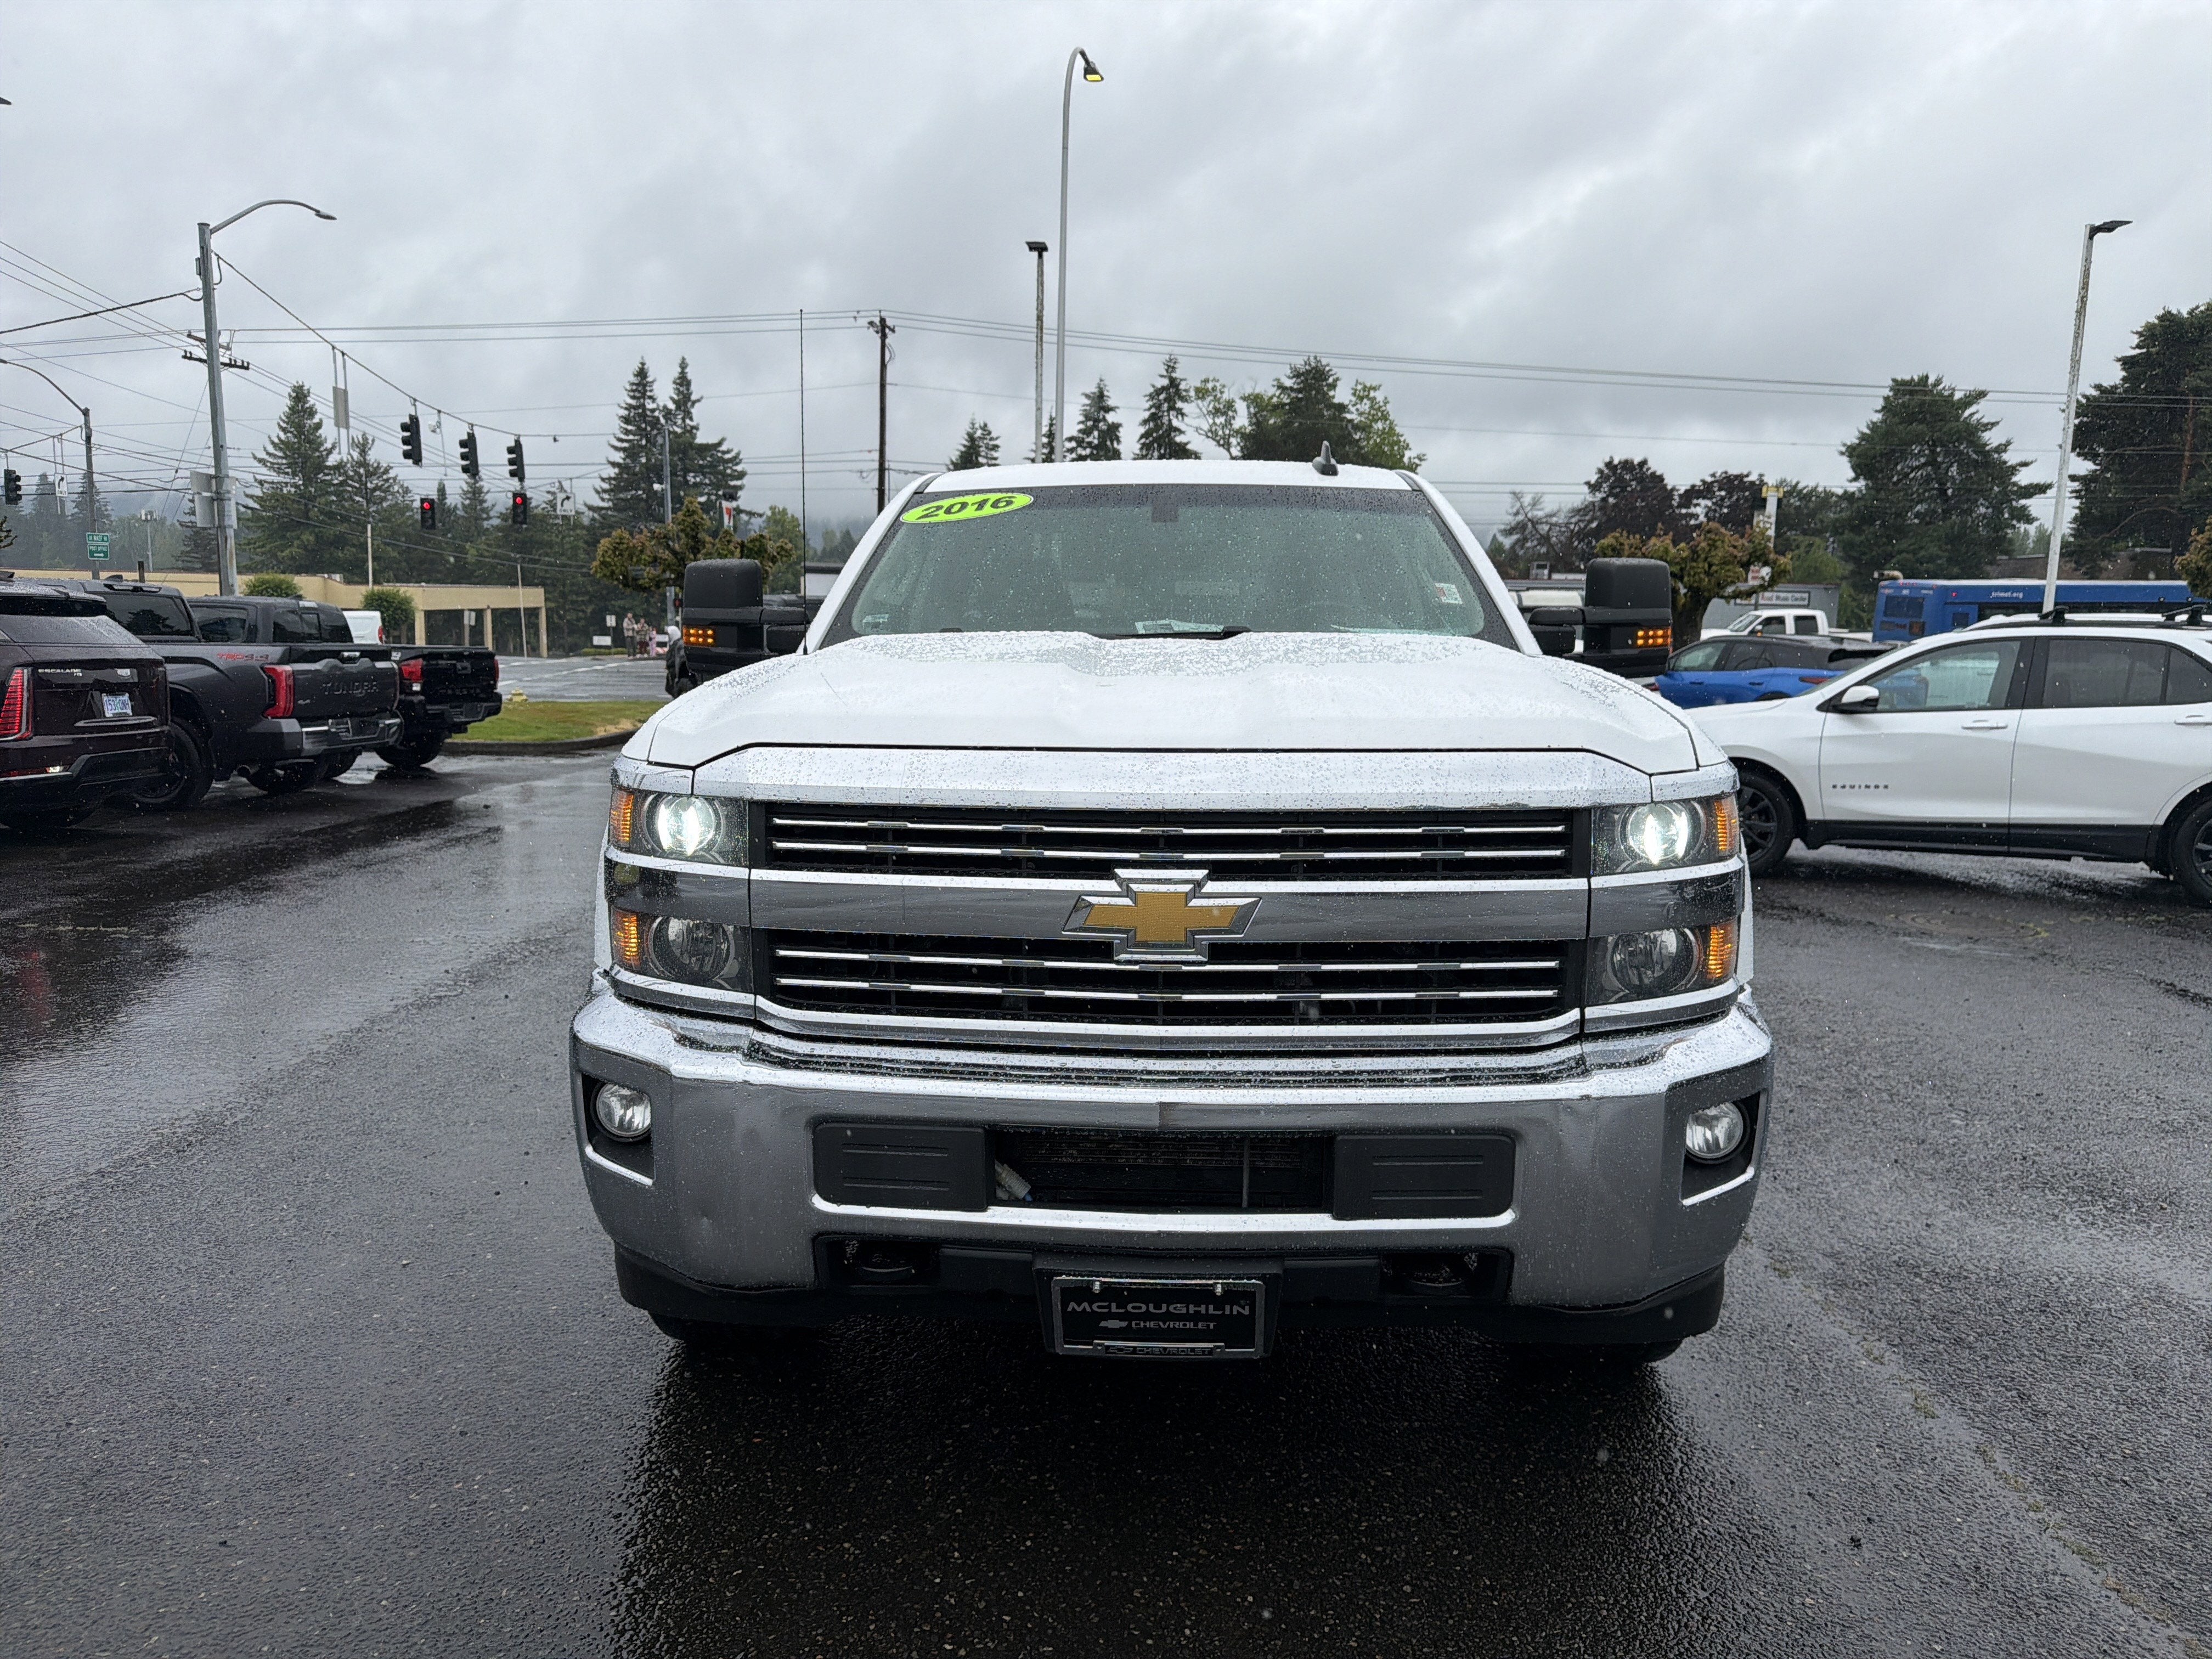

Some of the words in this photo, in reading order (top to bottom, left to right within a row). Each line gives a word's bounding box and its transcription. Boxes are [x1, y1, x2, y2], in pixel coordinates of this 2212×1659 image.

[916, 496, 1018, 521] 2016
[320, 682, 380, 695] TUNDRA
[1067, 1301, 1250, 1316] MCLOUGHLIN
[1132, 1321, 1217, 1329] CHEVROLET
[1136, 1347, 1211, 1355] CHEVROLET
